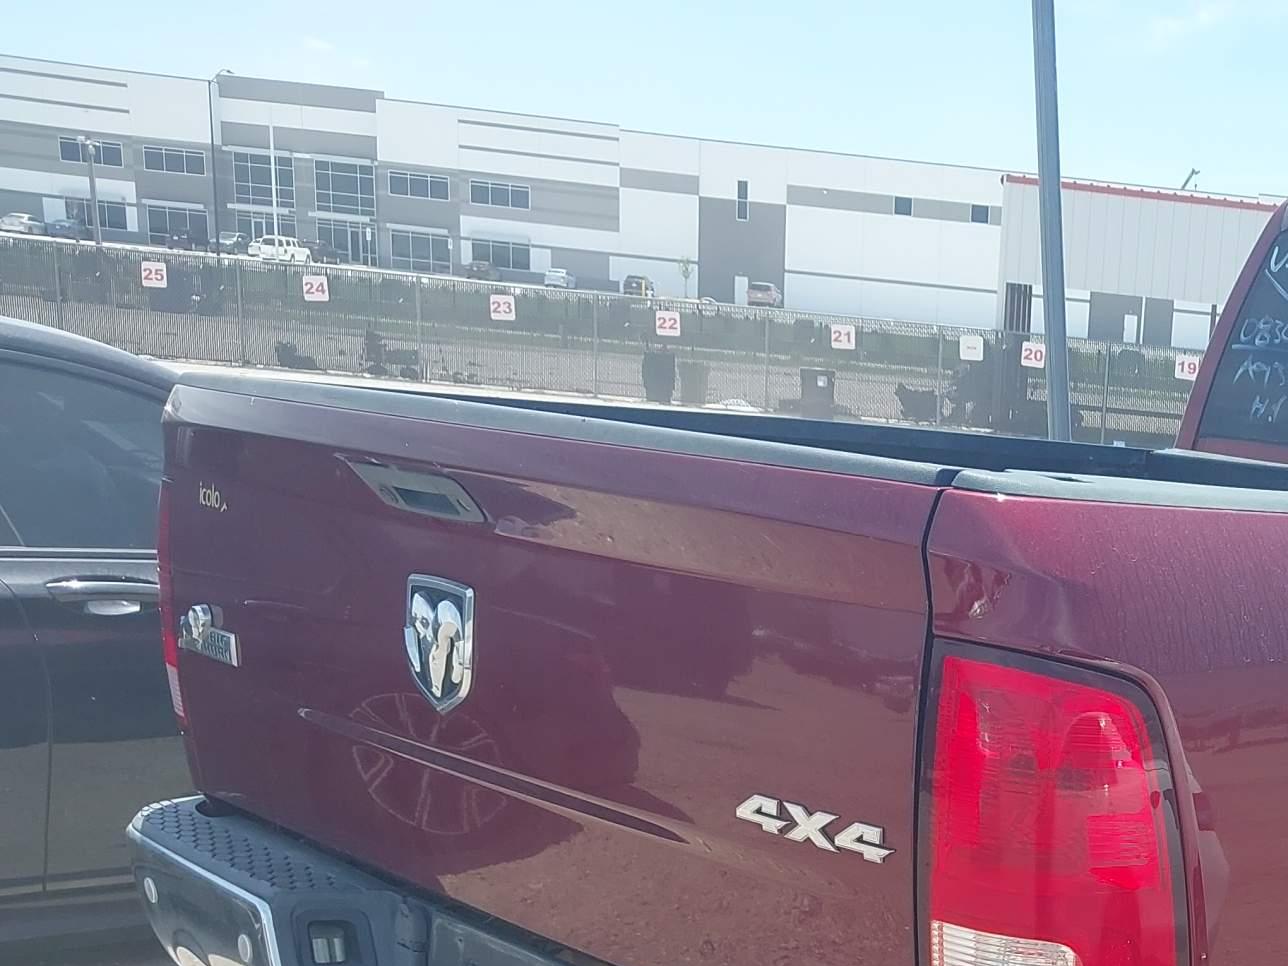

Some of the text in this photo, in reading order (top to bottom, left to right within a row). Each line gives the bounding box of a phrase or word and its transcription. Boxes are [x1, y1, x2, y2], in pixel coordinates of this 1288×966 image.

[143, 267, 165, 281] 25
[304, 281, 327, 295] 24
[491, 300, 513, 314] 23
[657, 316, 679, 330] 22
[832, 330, 852, 344] 21
[1023, 347, 1044, 362] 20
[1177, 360, 1198, 375] 19
